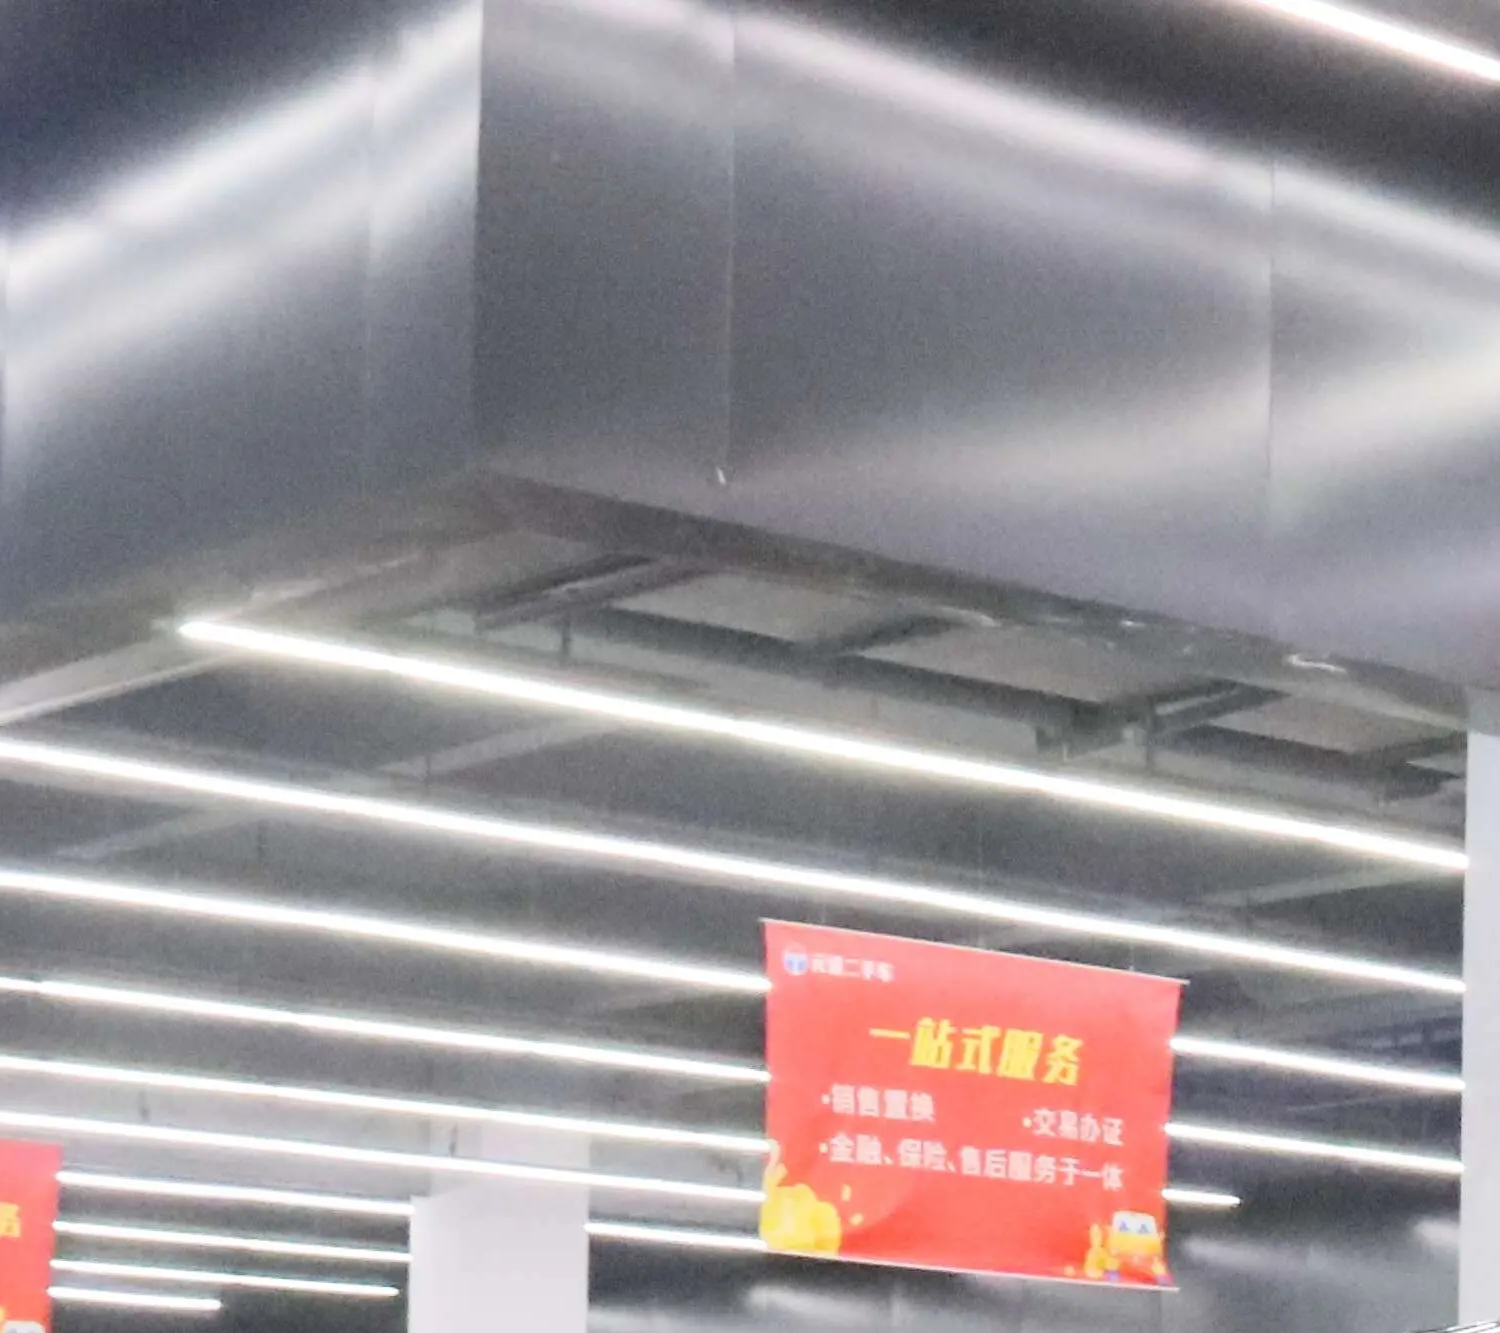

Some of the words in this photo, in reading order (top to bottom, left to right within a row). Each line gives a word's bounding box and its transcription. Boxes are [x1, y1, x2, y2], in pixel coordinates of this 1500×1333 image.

[868, 1016, 1084, 1086] 一站式服务
[831, 1083, 936, 1123] 销售置换
[1032, 1107, 1125, 1147] 交易办证
